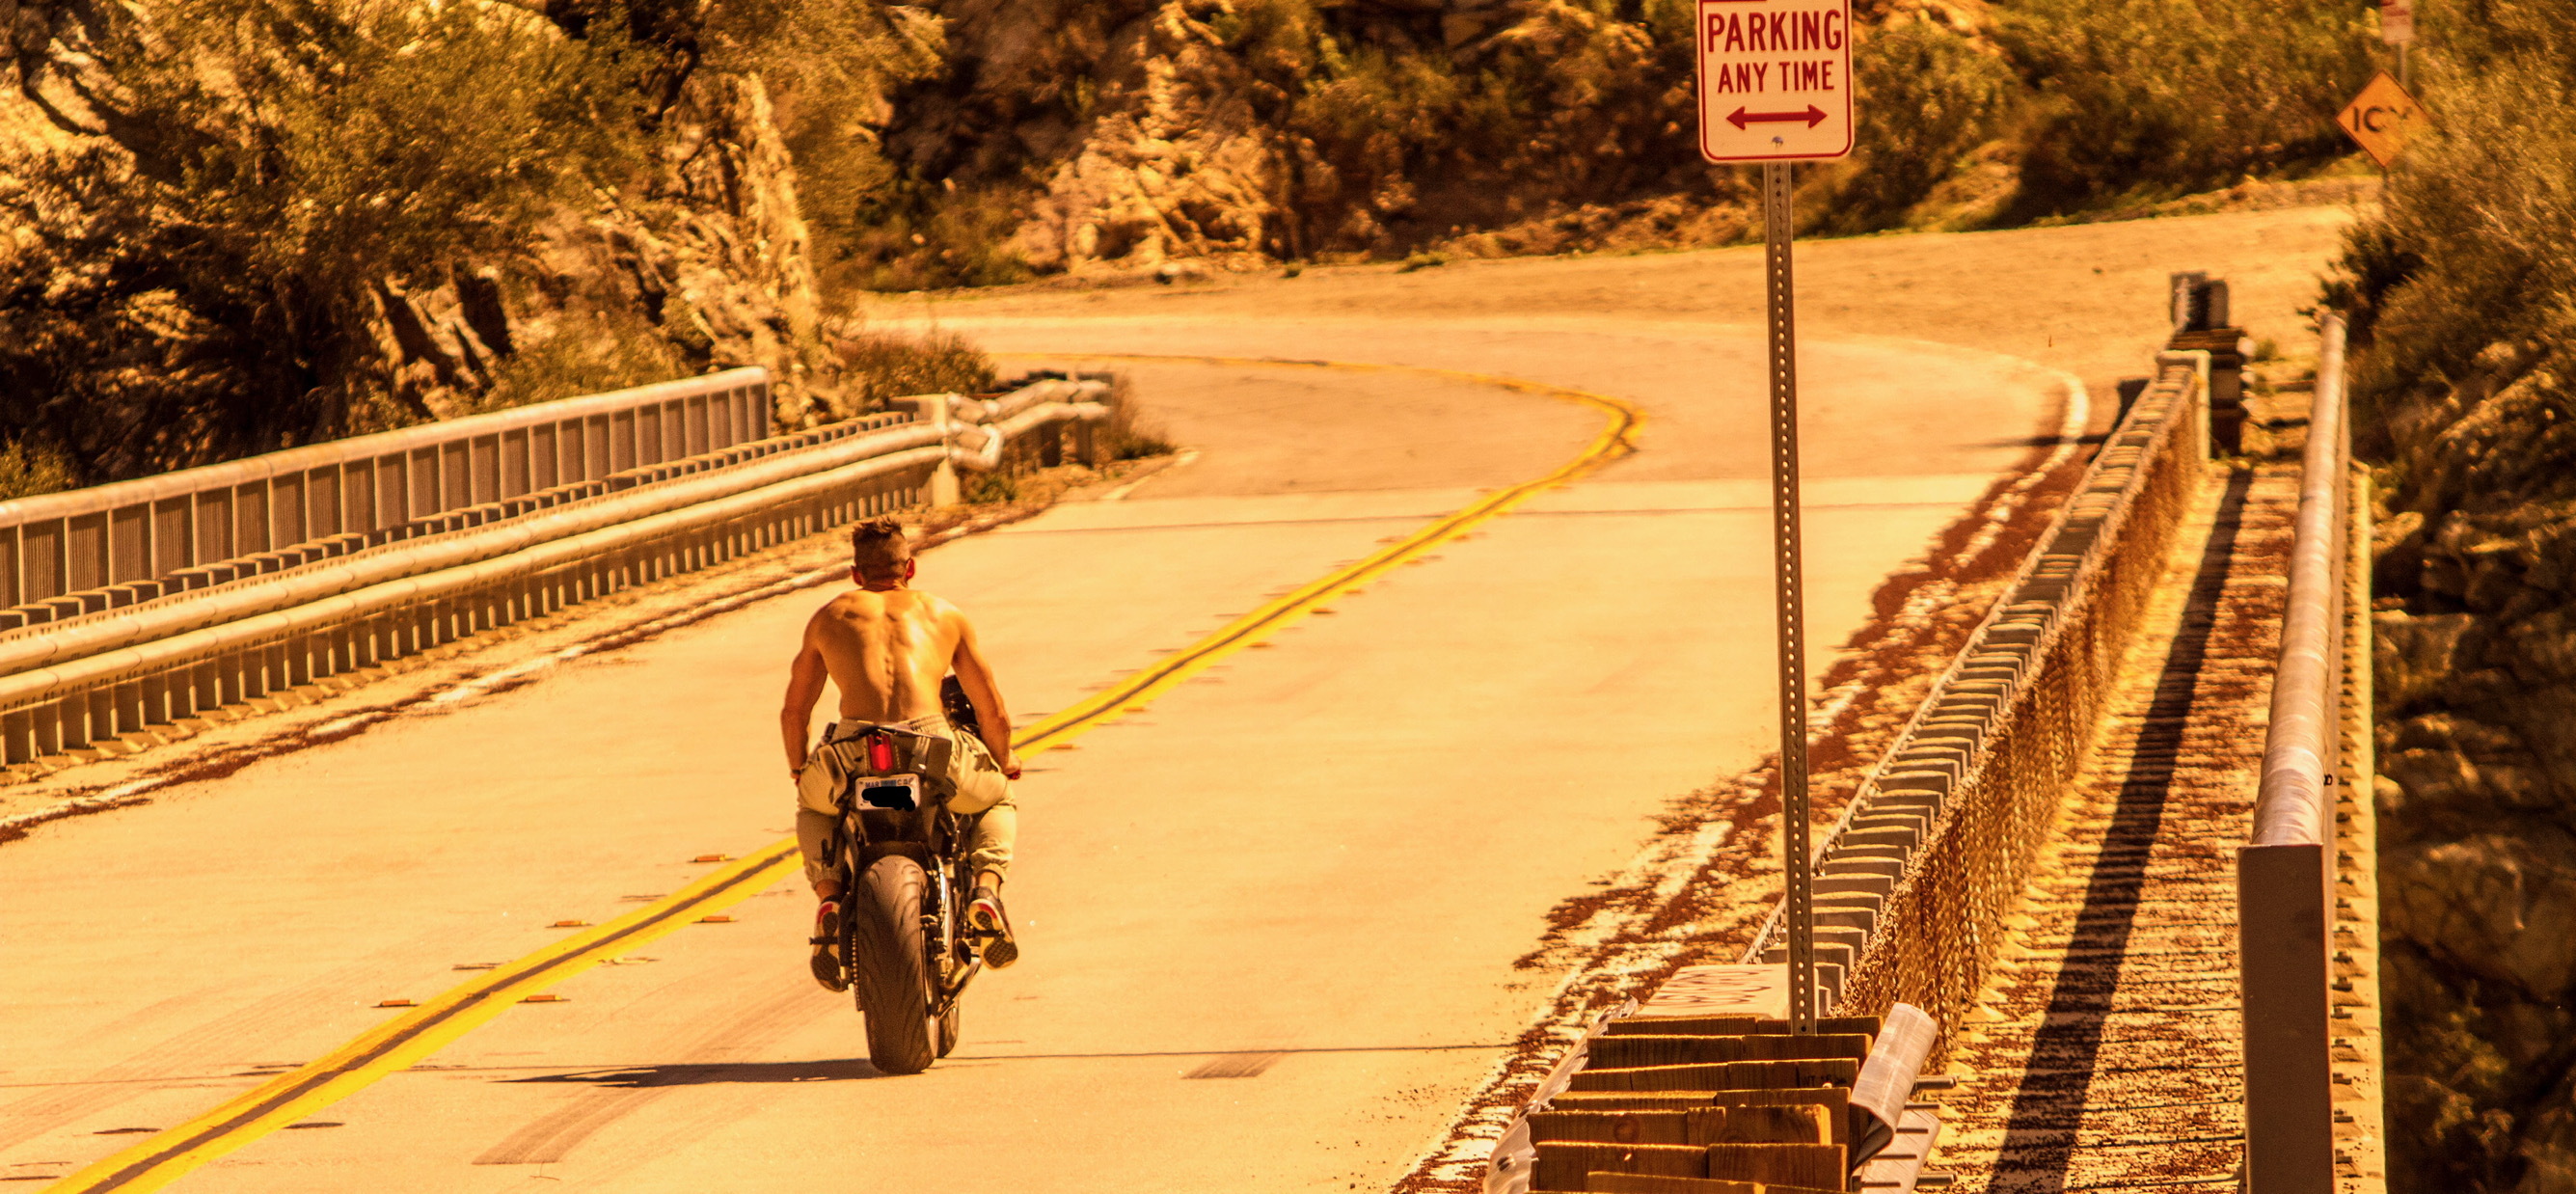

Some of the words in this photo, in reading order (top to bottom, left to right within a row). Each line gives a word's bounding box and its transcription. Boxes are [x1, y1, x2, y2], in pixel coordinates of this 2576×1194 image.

[1707, 10, 1842, 52] PARKING
[1718, 62, 1768, 93] ANY
[1778, 61, 1834, 92] TIME
